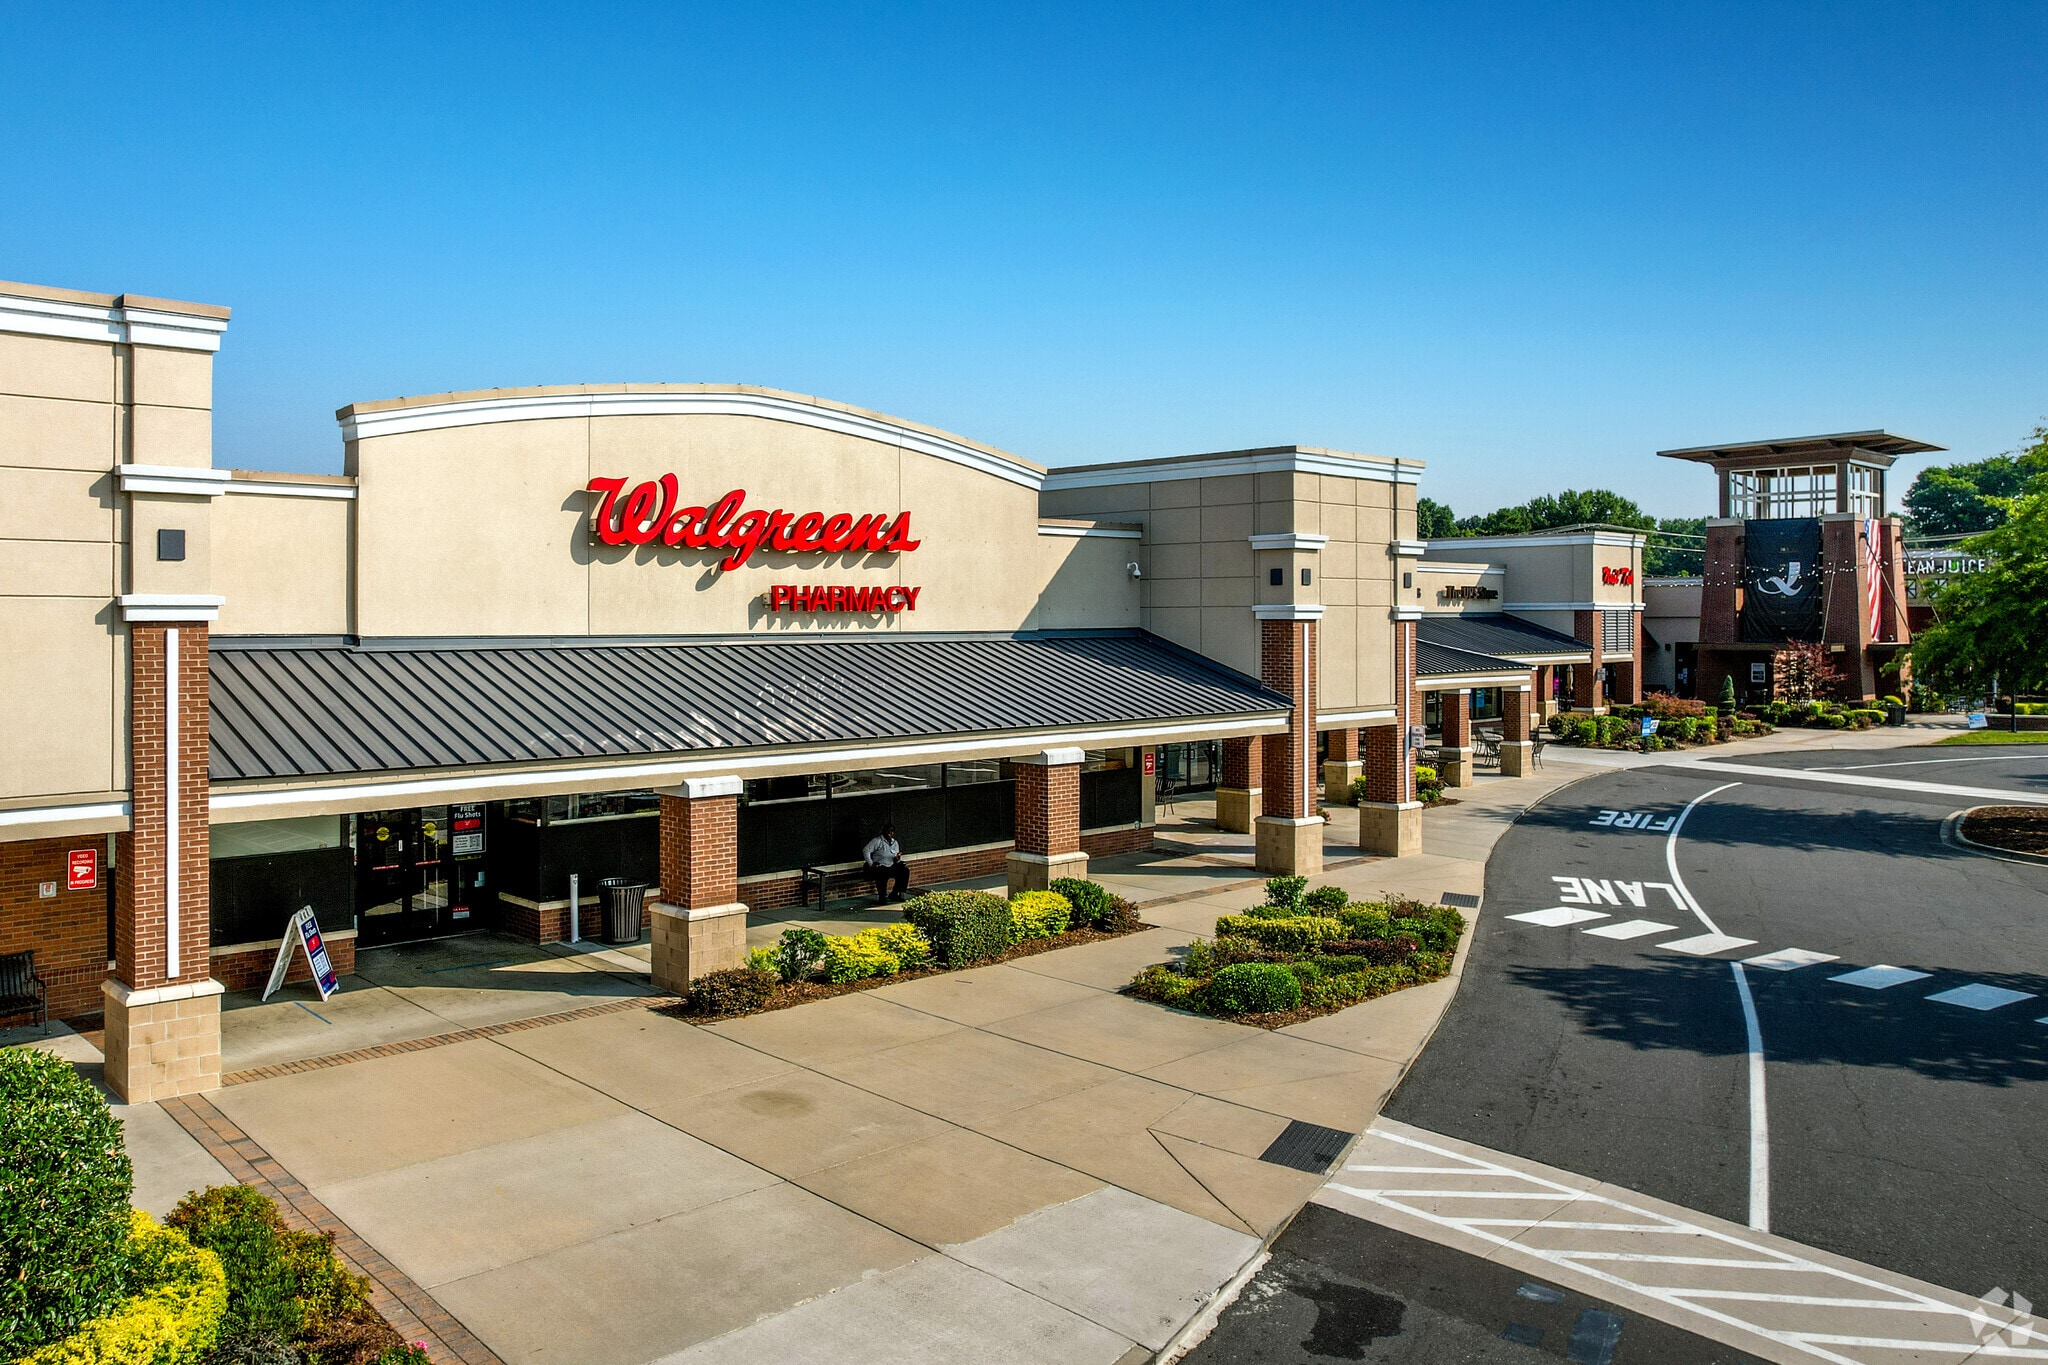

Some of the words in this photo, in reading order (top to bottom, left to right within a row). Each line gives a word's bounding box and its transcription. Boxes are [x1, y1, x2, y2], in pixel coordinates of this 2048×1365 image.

[587, 472, 921, 571] Walgreens
[1903, 559, 1935, 574] EAN
[1937, 559, 1986, 574] JUICE
[770, 585, 921, 611] PHARMACY
[1589, 810, 1677, 832] FIRE
[1551, 876, 1689, 911] LANE
